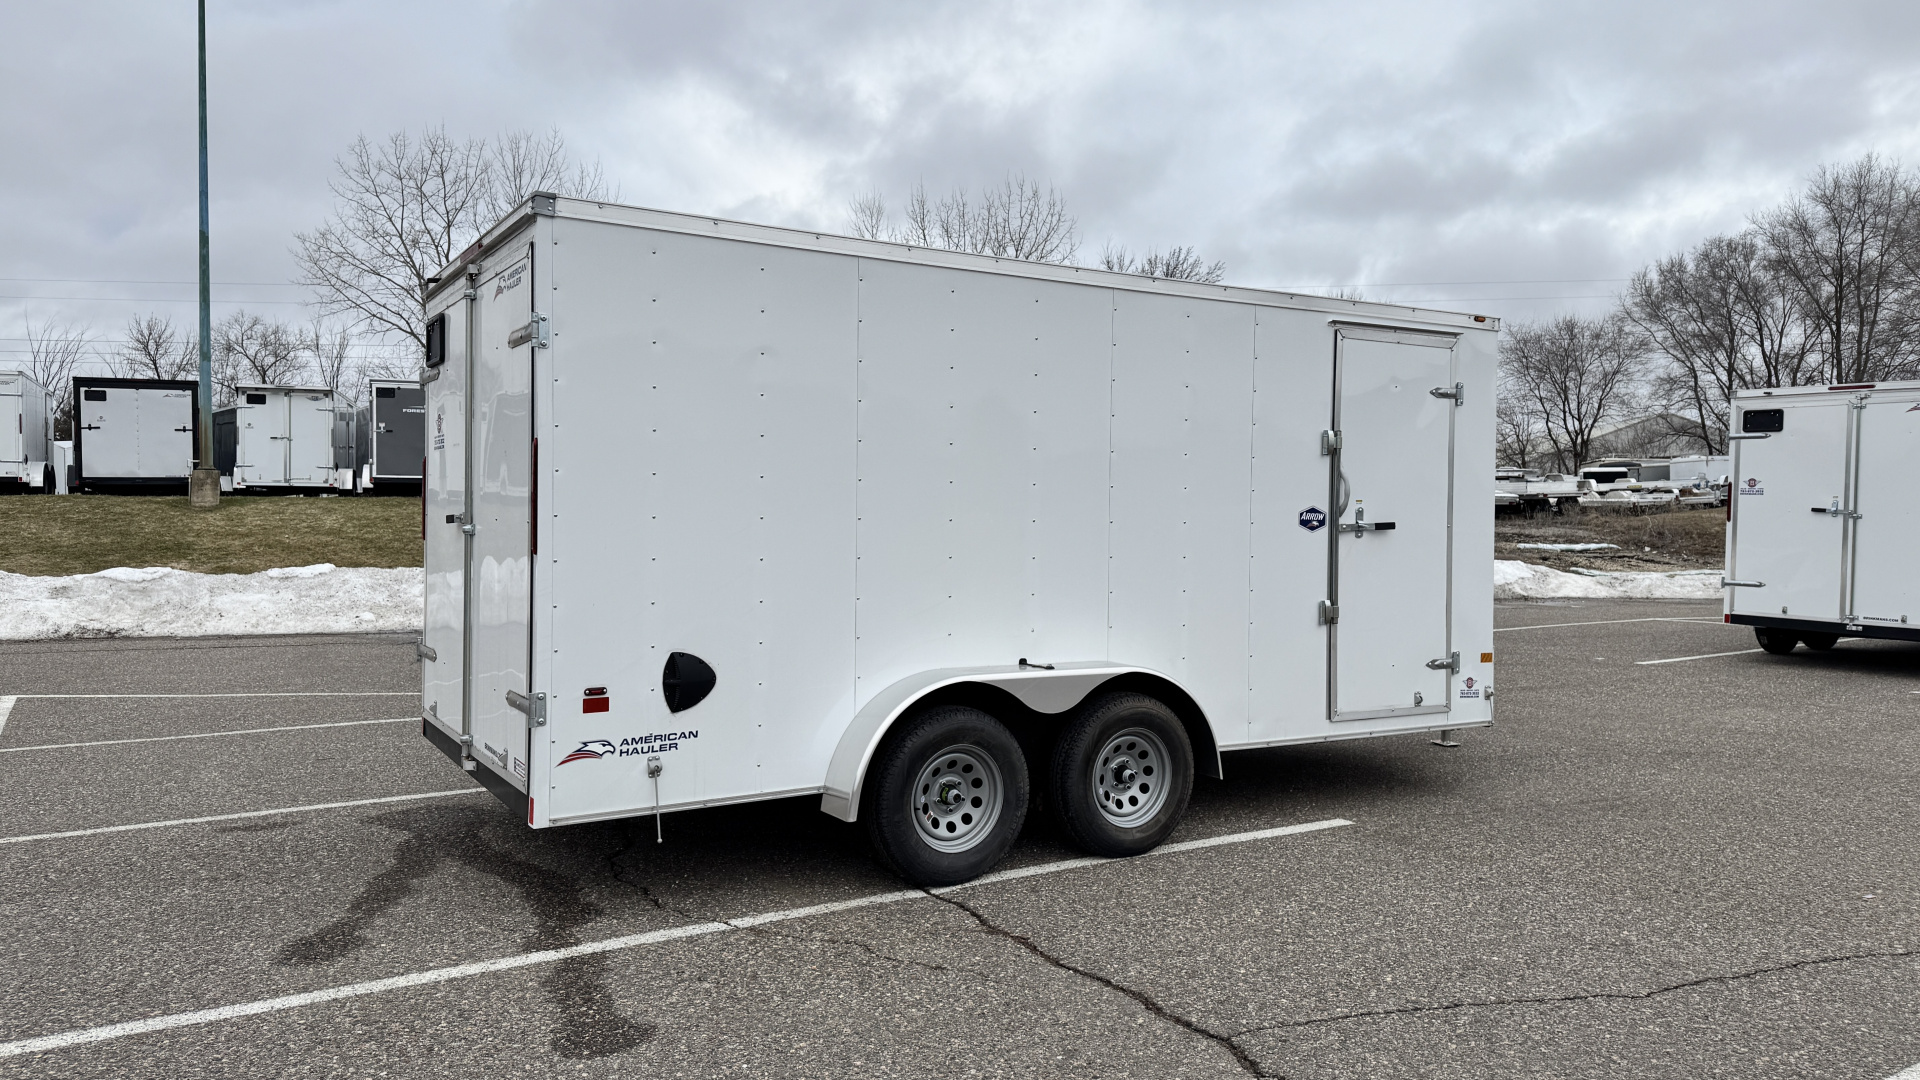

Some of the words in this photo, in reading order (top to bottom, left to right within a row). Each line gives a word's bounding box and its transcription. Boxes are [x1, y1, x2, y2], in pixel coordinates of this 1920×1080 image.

[506, 262, 527, 281] AMERICAN
[1300, 511, 1325, 521] ARROW
[619, 730, 699, 747] AMERICAN
[619, 742, 679, 757] HAULER
